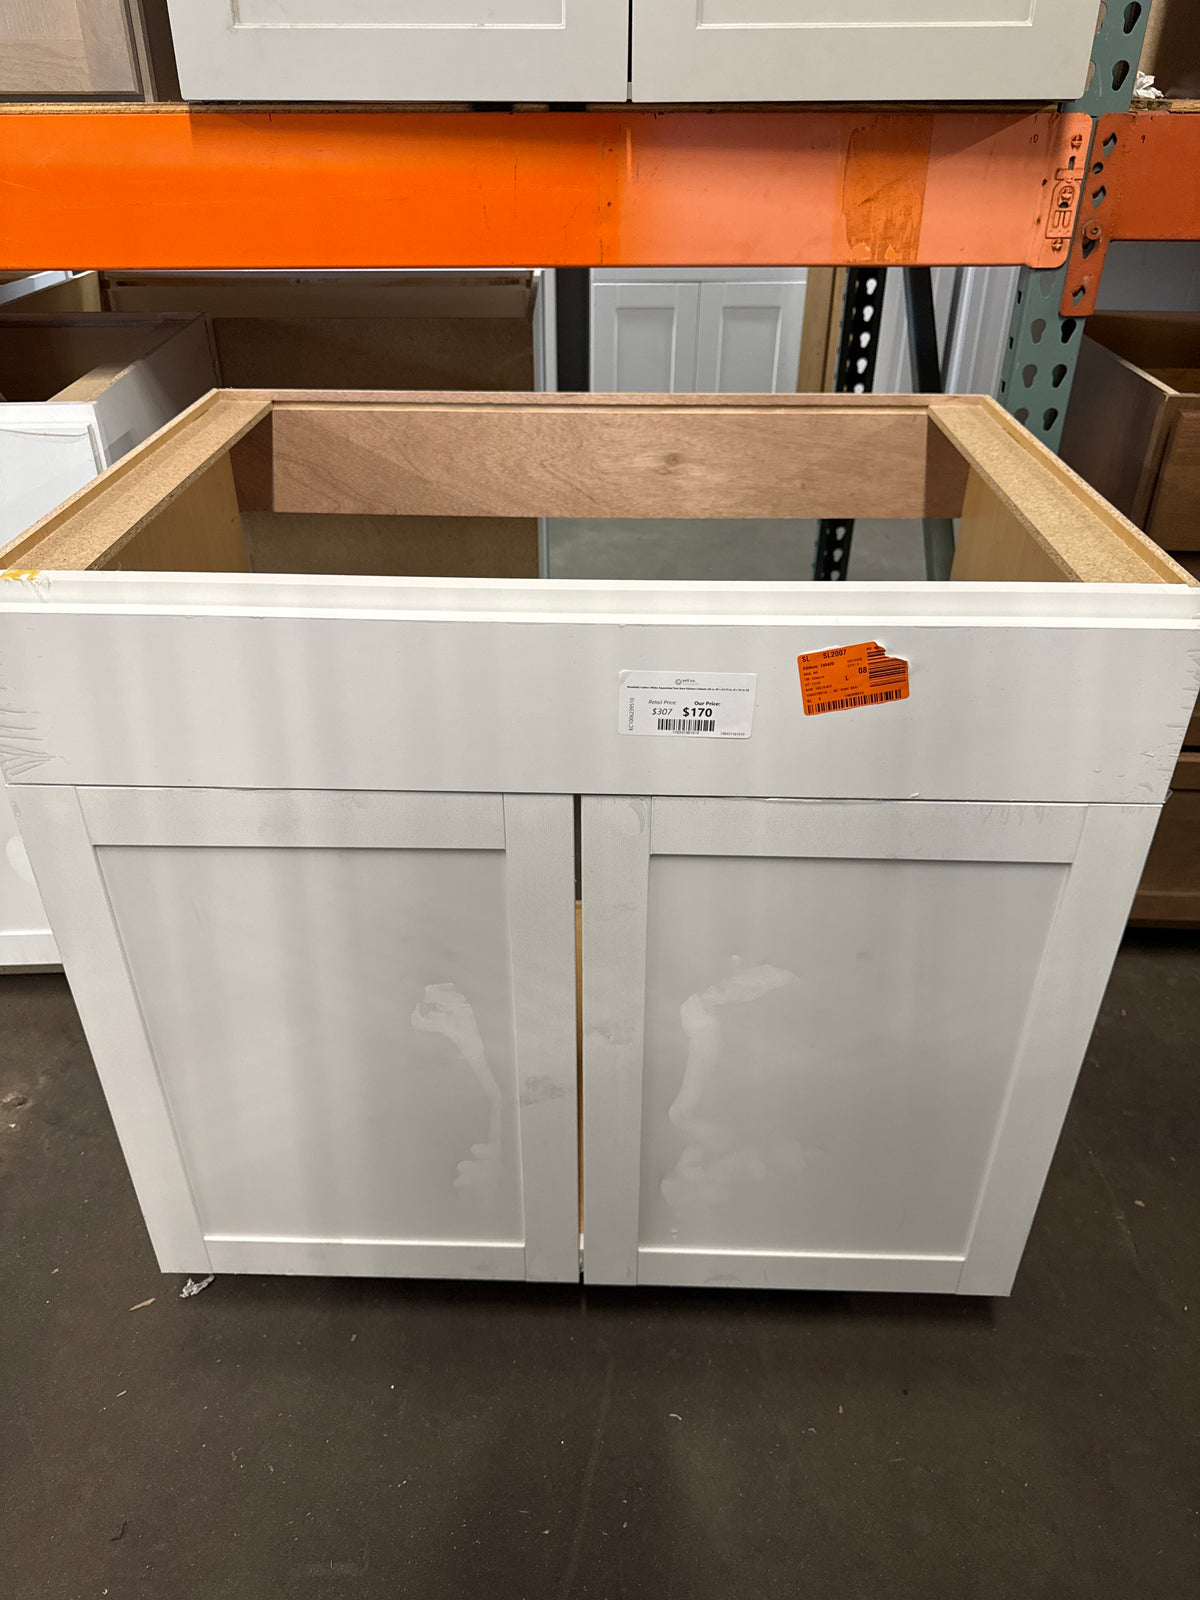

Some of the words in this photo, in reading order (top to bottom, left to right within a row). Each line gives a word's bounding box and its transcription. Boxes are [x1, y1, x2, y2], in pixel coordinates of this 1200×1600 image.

[822, 649, 847, 659] SL2007
[858, 666, 867, 674] 08
[652, 707, 673, 716] $307
[682, 706, 713, 718] $170
